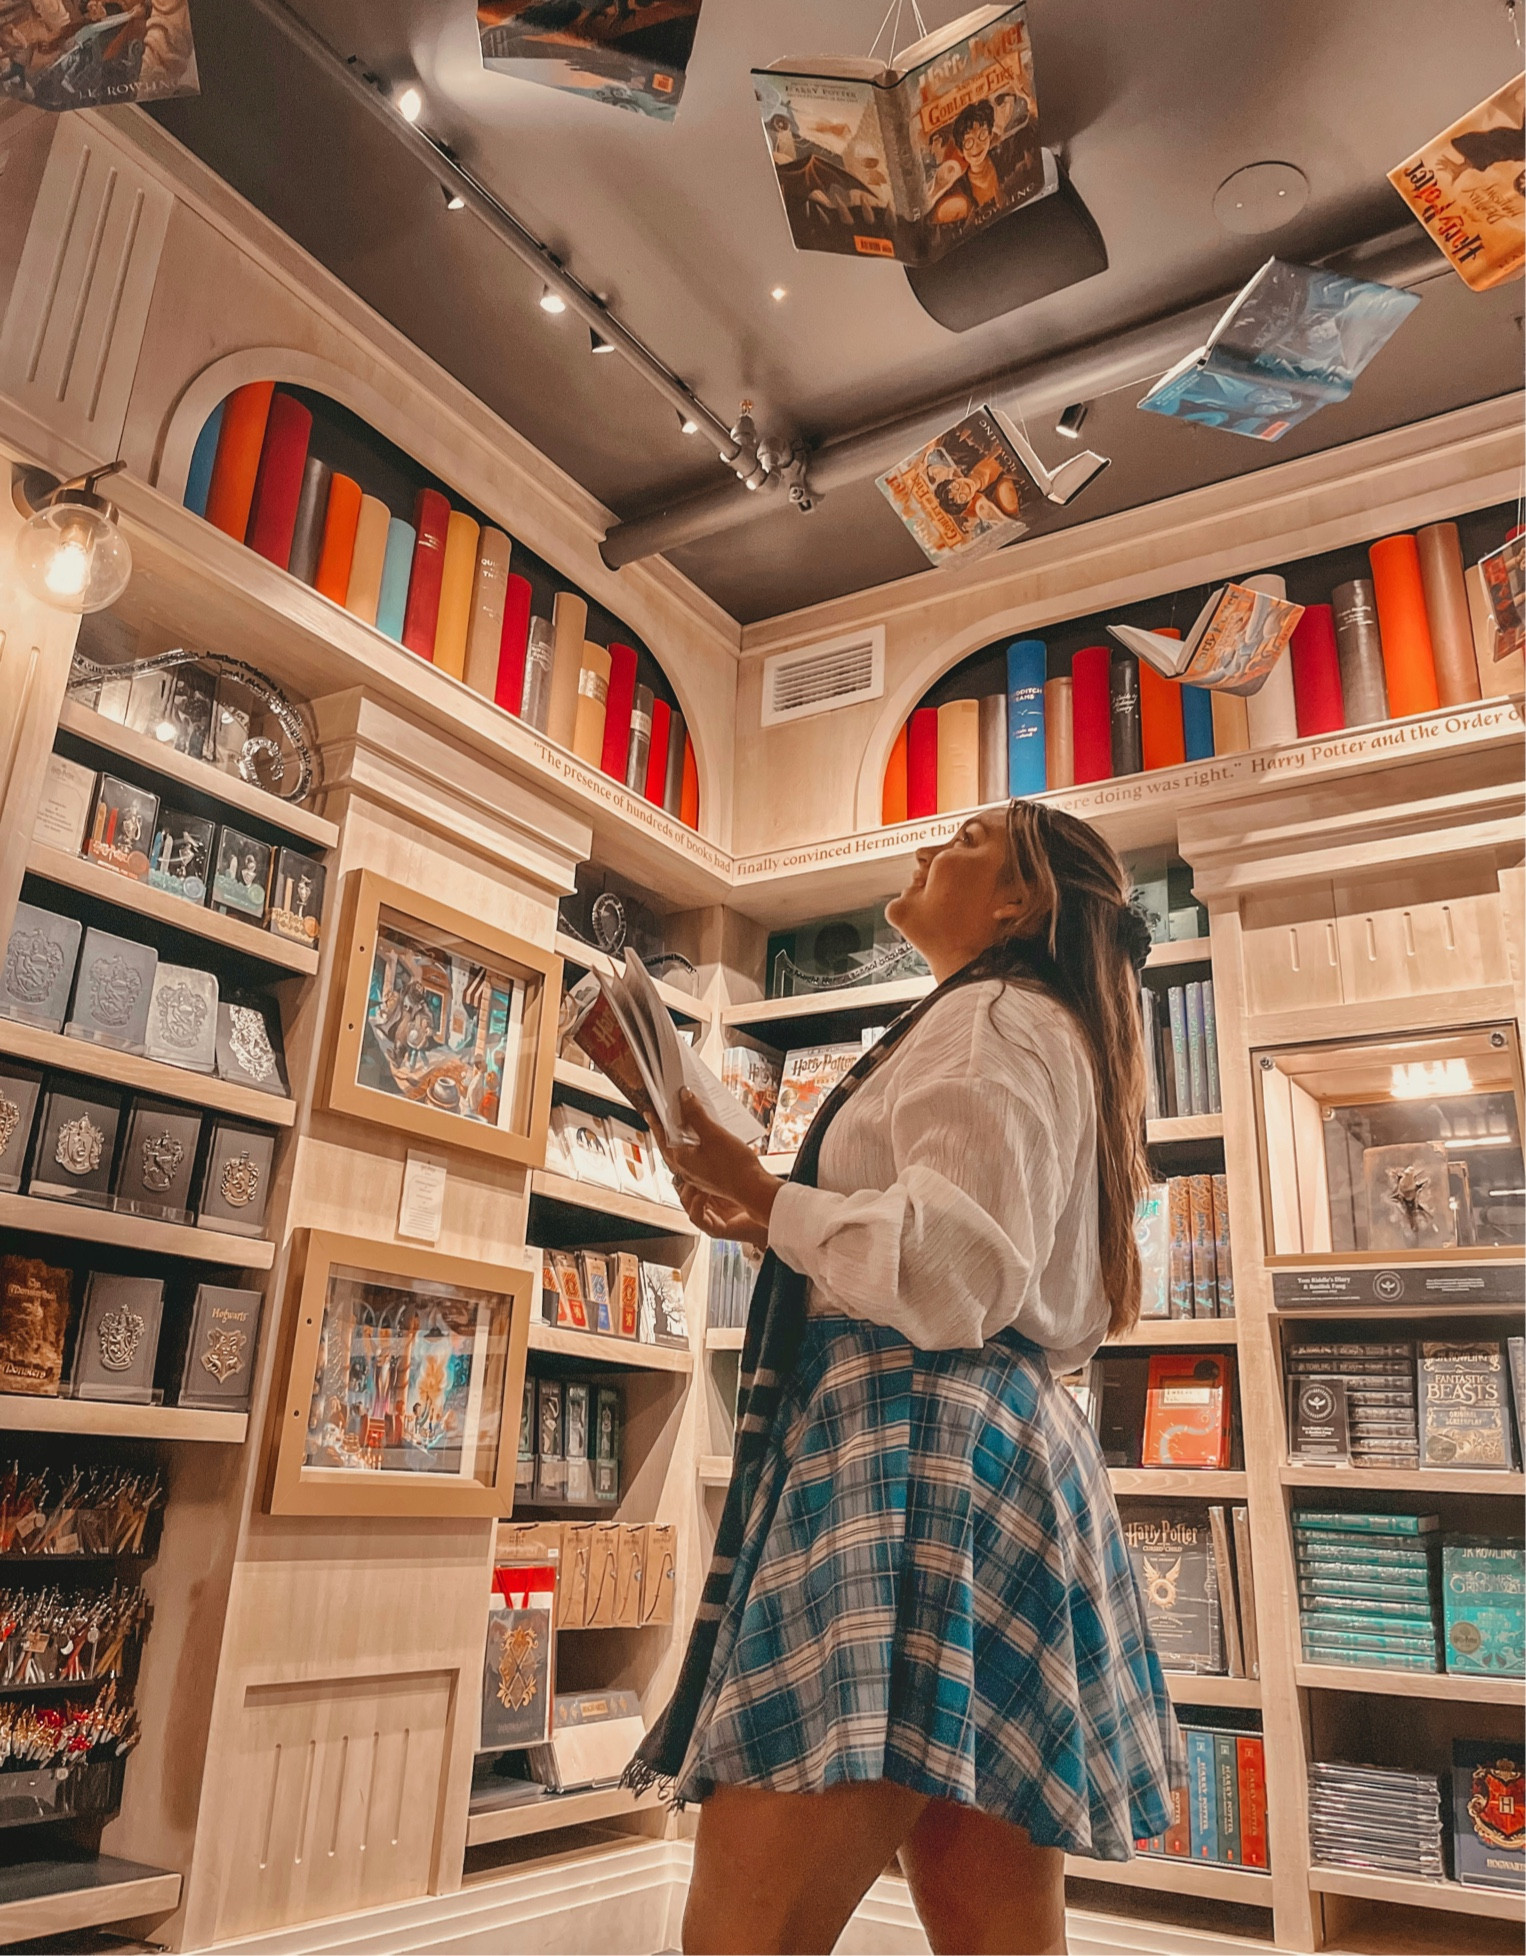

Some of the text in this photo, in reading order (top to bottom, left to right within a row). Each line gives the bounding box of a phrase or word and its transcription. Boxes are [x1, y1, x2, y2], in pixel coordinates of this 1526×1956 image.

[1403, 159, 1457, 225] Potter
[1438, 215, 1485, 264] Harry
[563, 763, 611, 800] presence
[613, 791, 626, 809] of
[626, 798, 673, 838] hundreds
[674, 830, 687, 845] of
[687, 836, 713, 863] books
[714, 853, 731, 874] had
[737, 856, 780, 876] finally
[783, 844, 851, 867] convinced
[855, 830, 927, 853] Hermione
[1094, 785, 1142, 805] doing
[1146, 779, 1180, 794] was
[1251, 750, 1305, 774] Harry
[1311, 739, 1366, 761] Potter
[1370, 729, 1406, 749] and
[1410, 721, 1440, 741] the
[1444, 709, 1504, 734] Order
[792, 1053, 858, 1077] Harry Potter
[211, 1307, 250, 1324] Hogwarts
[1426, 1382, 1499, 1405] BEASTS
[1435, 1374, 1489, 1384] FANTASTIC
[1125, 1520, 1198, 1548] Harry Potter
[1200, 1762, 1208, 1794] HARRY
[1225, 1765, 1233, 1798] HARRY
[1200, 1797, 1209, 1831] POTTER
[1226, 1801, 1234, 1834] POTTER
[1501, 1797, 1512, 1812] H
